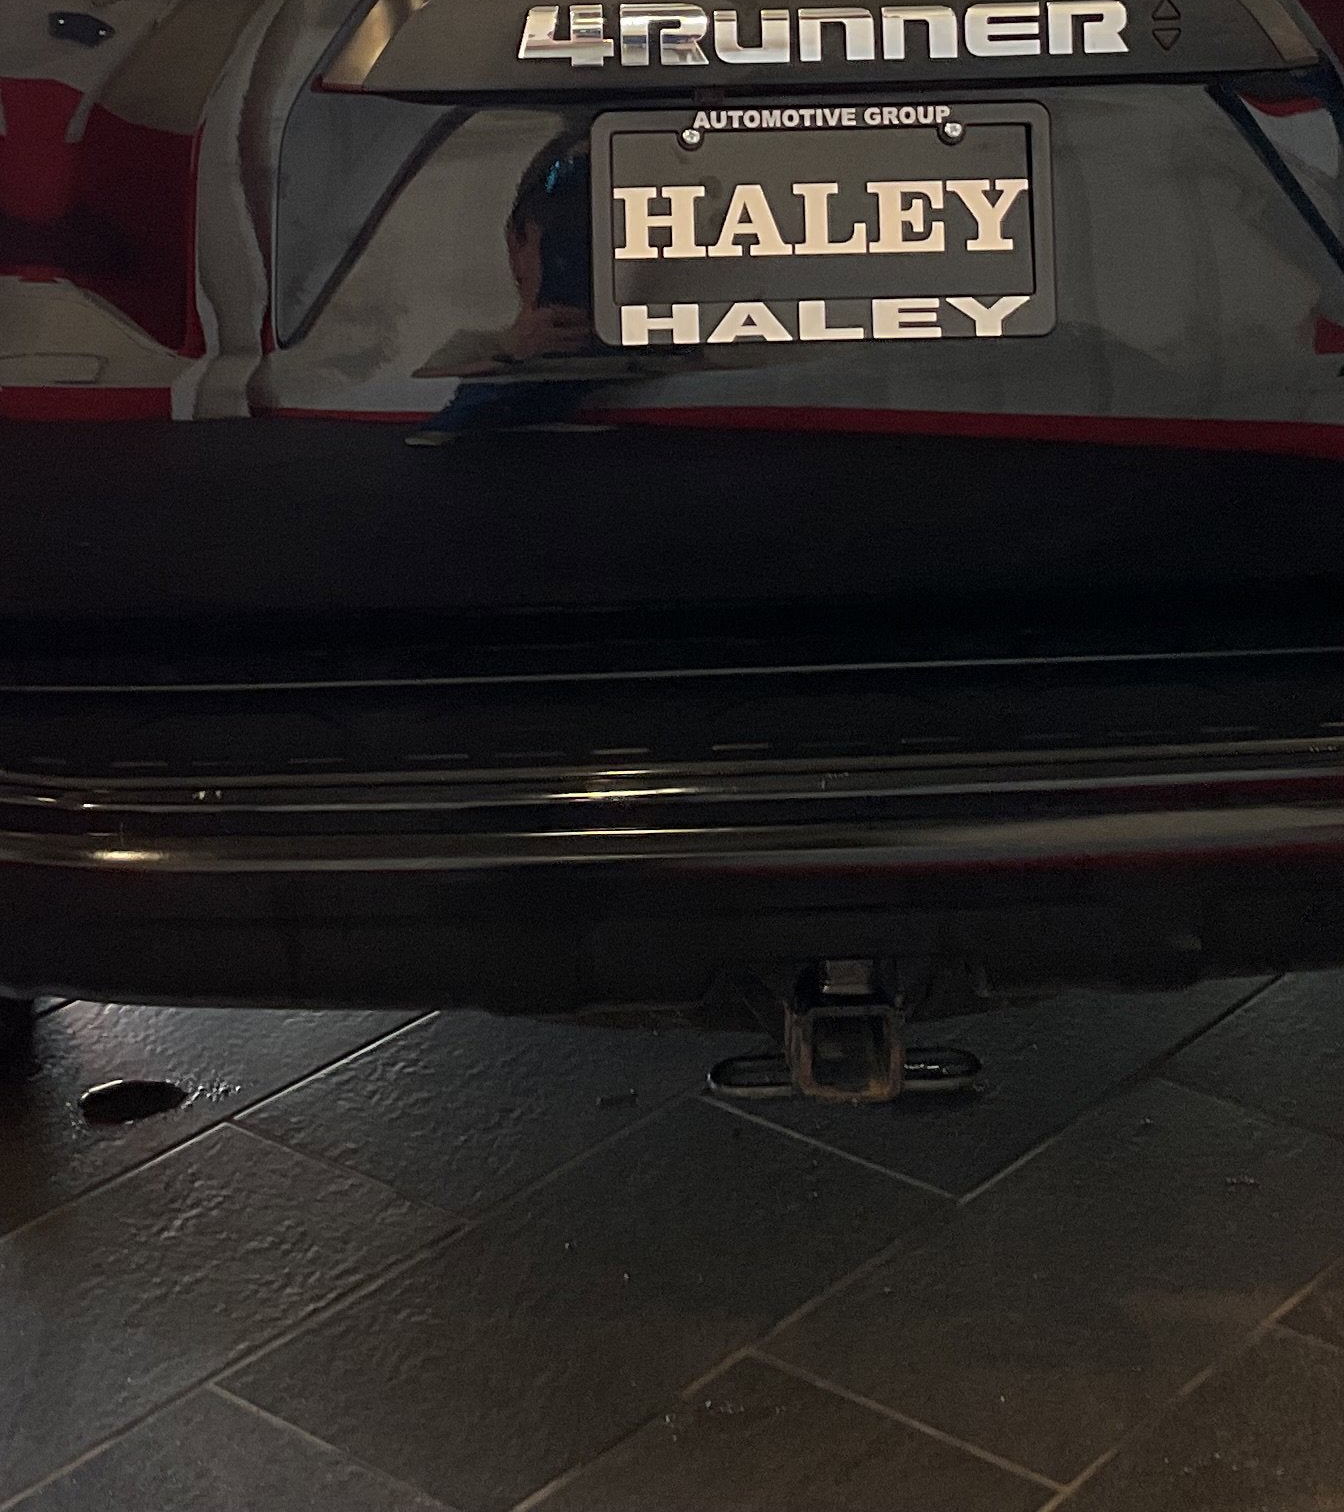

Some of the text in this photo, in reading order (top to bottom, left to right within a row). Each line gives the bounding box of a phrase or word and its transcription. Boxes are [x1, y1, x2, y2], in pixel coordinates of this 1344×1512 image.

[692, 104, 952, 131] AUTOMOTIVE GROUP
[613, 178, 1029, 260] HALEY
[619, 295, 1031, 347] HALEY
